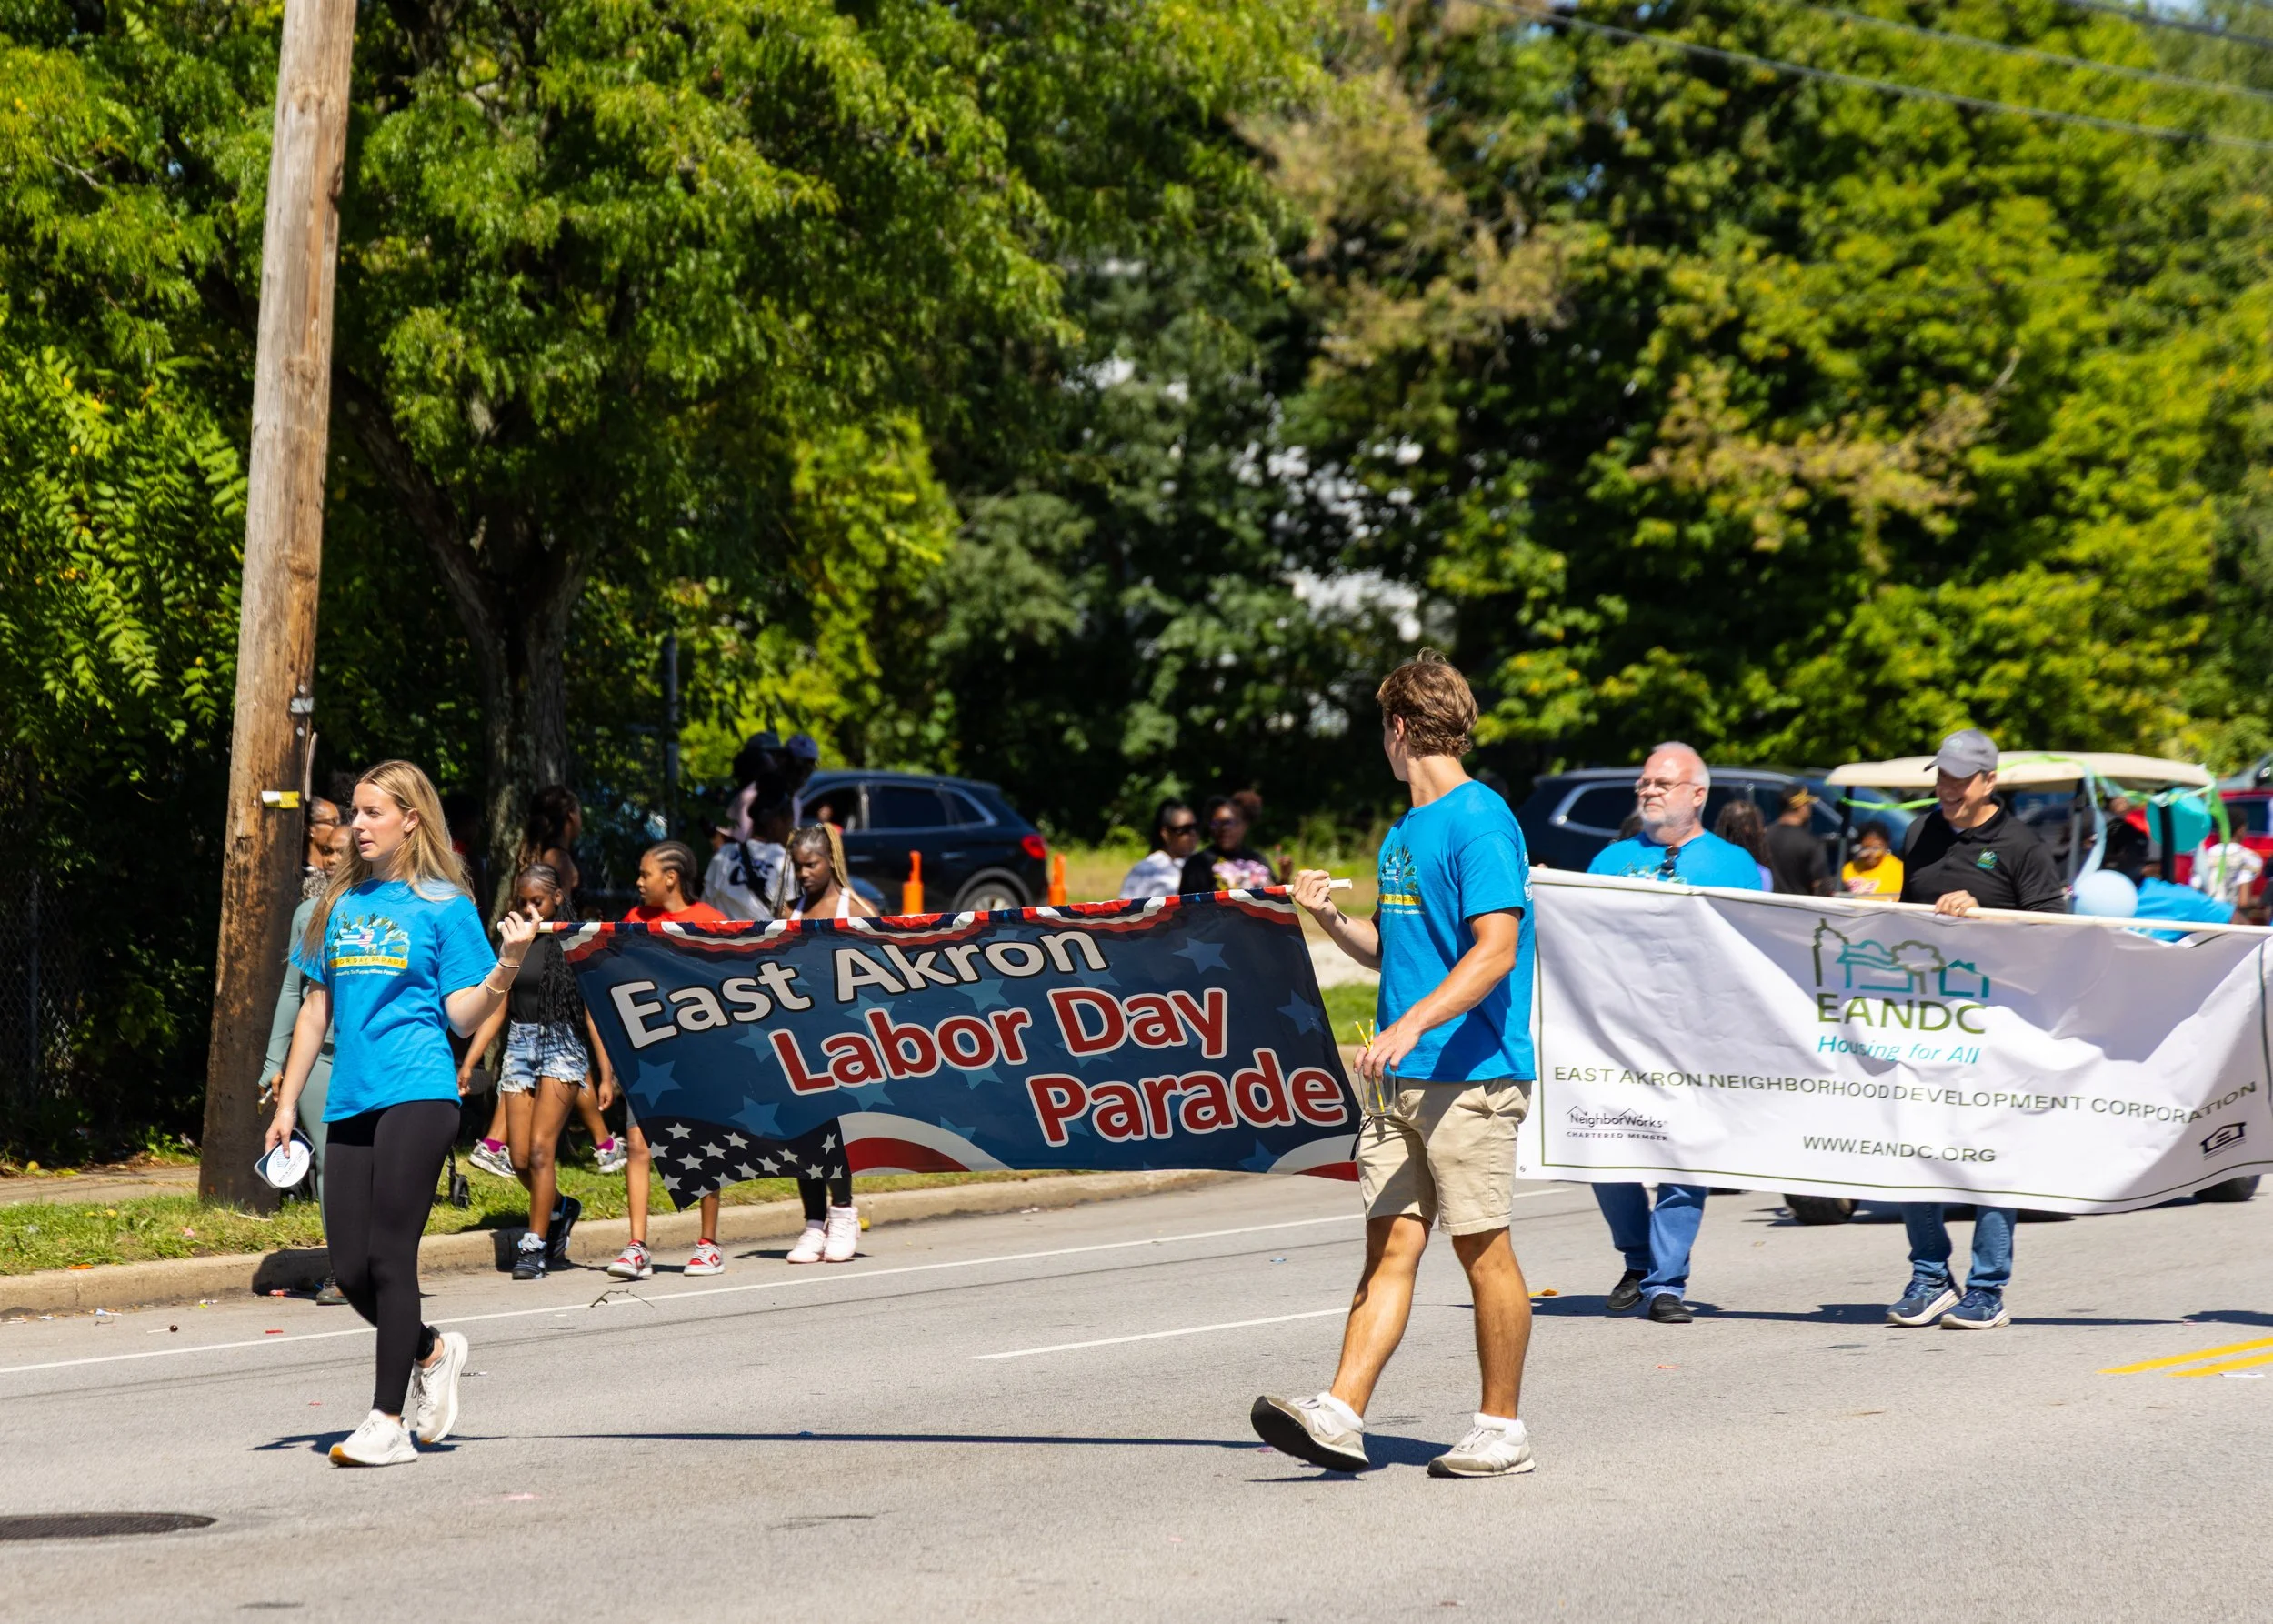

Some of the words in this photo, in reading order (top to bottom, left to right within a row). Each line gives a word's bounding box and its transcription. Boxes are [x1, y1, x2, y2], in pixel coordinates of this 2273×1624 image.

[611, 962, 811, 1049] East
[836, 930, 1106, 1001] Akron
[1817, 993, 1987, 1034] EANDC
[770, 1007, 1033, 1097] Labor
[1047, 987, 1228, 1060] Day
[1818, 1036, 1902, 1062] Housing
[1908, 1043, 1942, 1061] for
[1947, 1046, 1982, 1064] All
[1026, 1048, 1349, 1147] Parade
[1554, 1066, 1614, 1083] EAST
[1619, 1068, 1703, 1088] AKRON
[1708, 1073, 1889, 1099] NEIGHBORHOOD
[1893, 1085, 2086, 1111] DEVELOPMENT
[2091, 1080, 2258, 1125] CORPORATION
[1566, 1131, 1624, 1139] CHARTERED
[1627, 1133, 1668, 1142] MEMBER
[1803, 1136, 1997, 1163] WWW.EANDC.ORG
